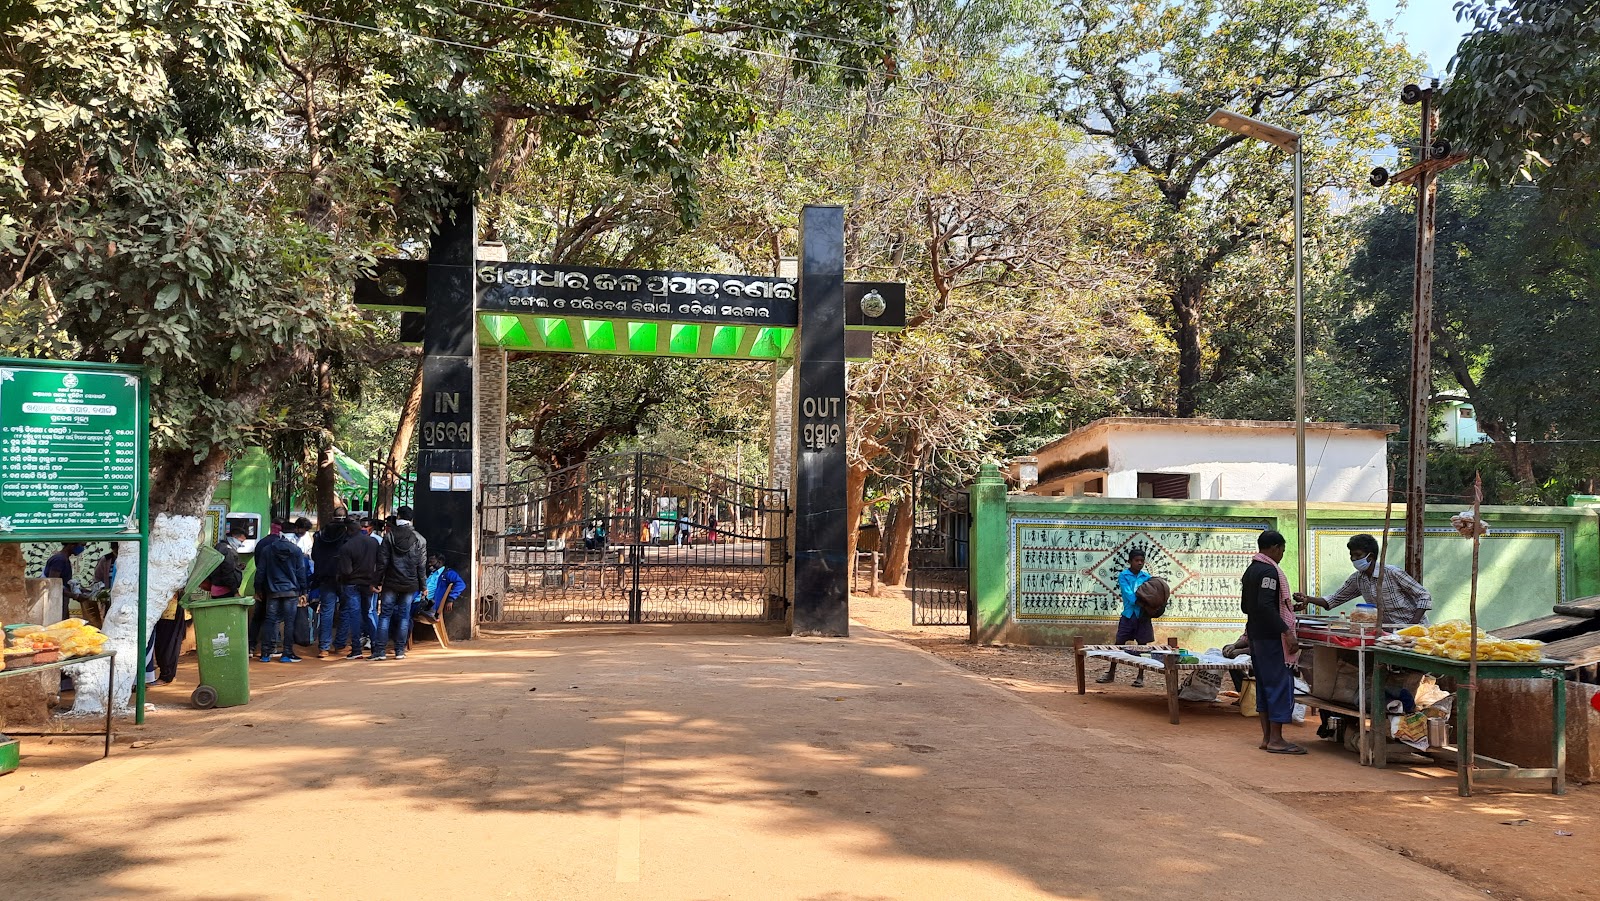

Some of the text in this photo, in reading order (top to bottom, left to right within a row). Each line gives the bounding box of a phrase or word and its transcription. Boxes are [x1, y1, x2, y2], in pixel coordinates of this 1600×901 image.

[478, 265, 590, 291] ଖଣ୍ଡାଧାର
[593, 273, 642, 292] ଜଳ
[553, 298, 566, 308] ଓ
[570, 296, 627, 311] ପରିବେଶ
[721, 305, 770, 318] ସରକାର
[434, 391, 460, 413] IN
[803, 397, 840, 417] OUT
[423, 421, 470, 446] ପ୍ରବେଶ
[804, 424, 840, 449] ପ୍ରସ୍ଥାନ
